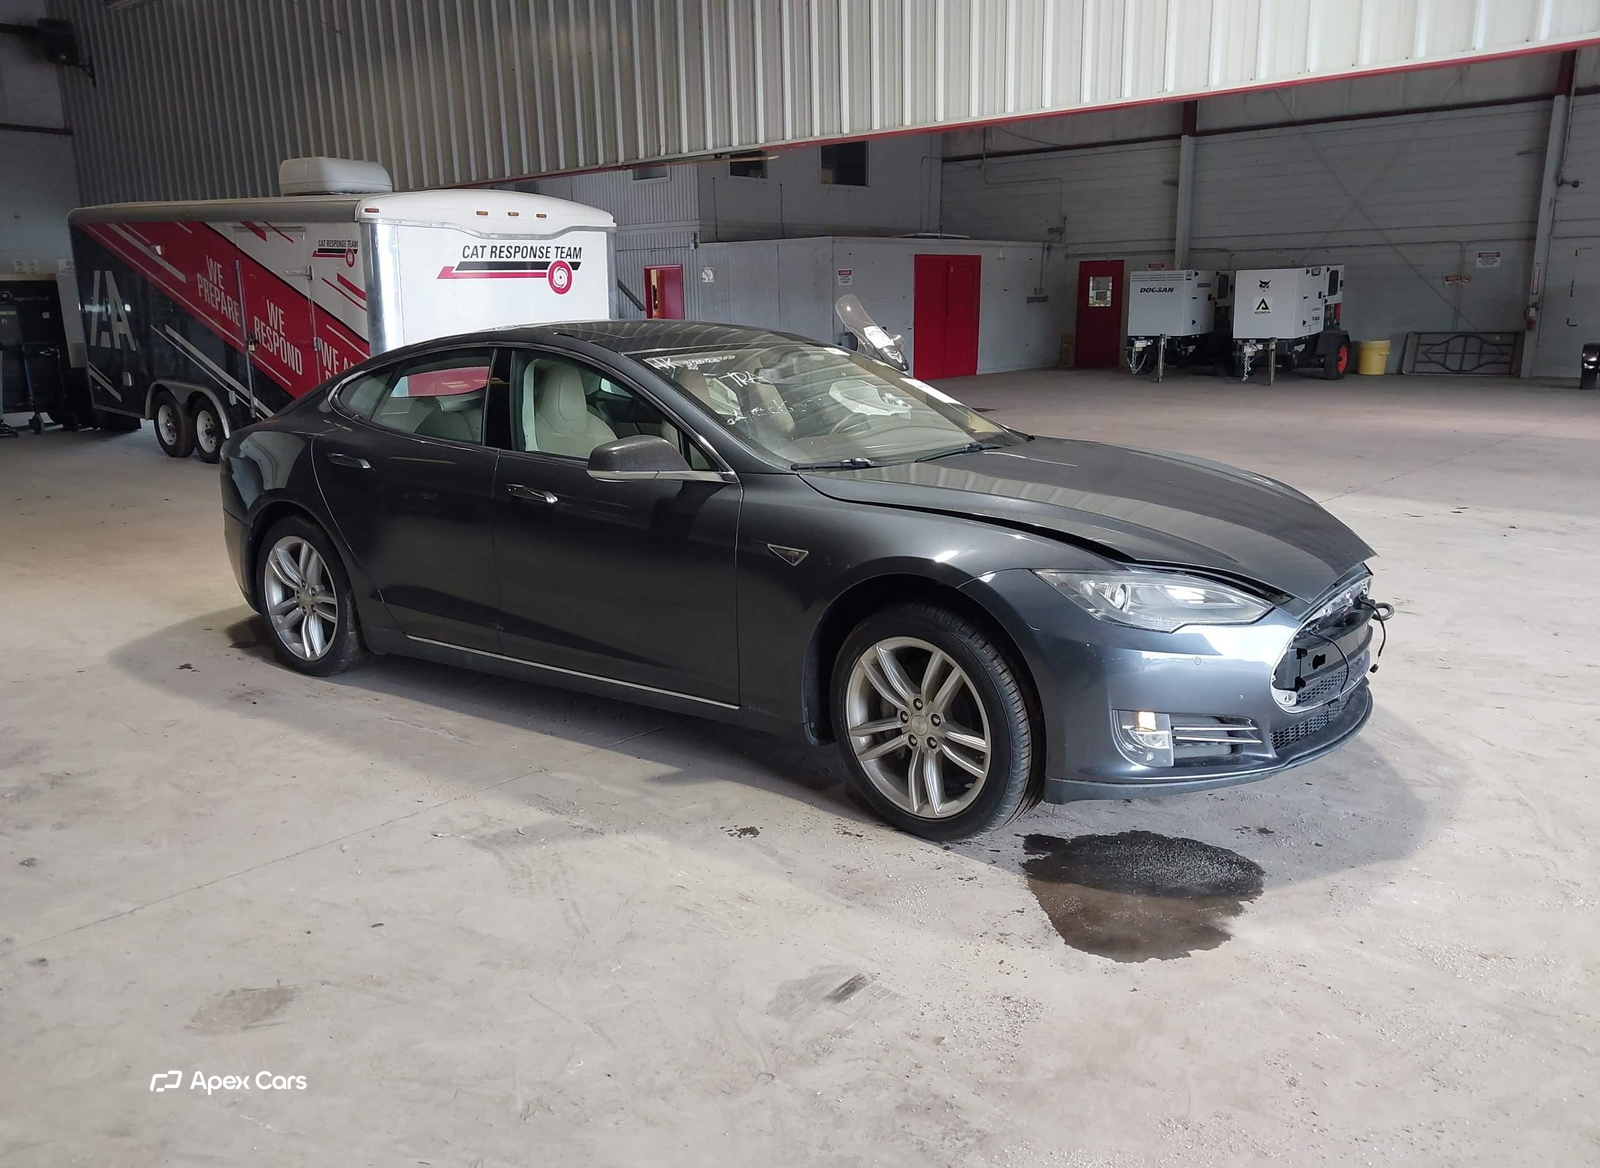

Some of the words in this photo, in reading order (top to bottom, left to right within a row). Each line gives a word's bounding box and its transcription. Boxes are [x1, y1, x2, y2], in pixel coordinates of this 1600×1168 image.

[318, 239, 326, 248] CAT
[327, 239, 347, 248] RESPONSE
[348, 239, 359, 248] TEAM
[462, 245, 487, 259] CAT
[490, 245, 552, 259] RESPONSE
[554, 245, 582, 260] TEAM
[206, 254, 225, 290] WE
[197, 272, 242, 328] PREPARE
[266, 298, 286, 337] WE
[254, 315, 303, 376] RESPOND
[319, 337, 340, 375] WE
